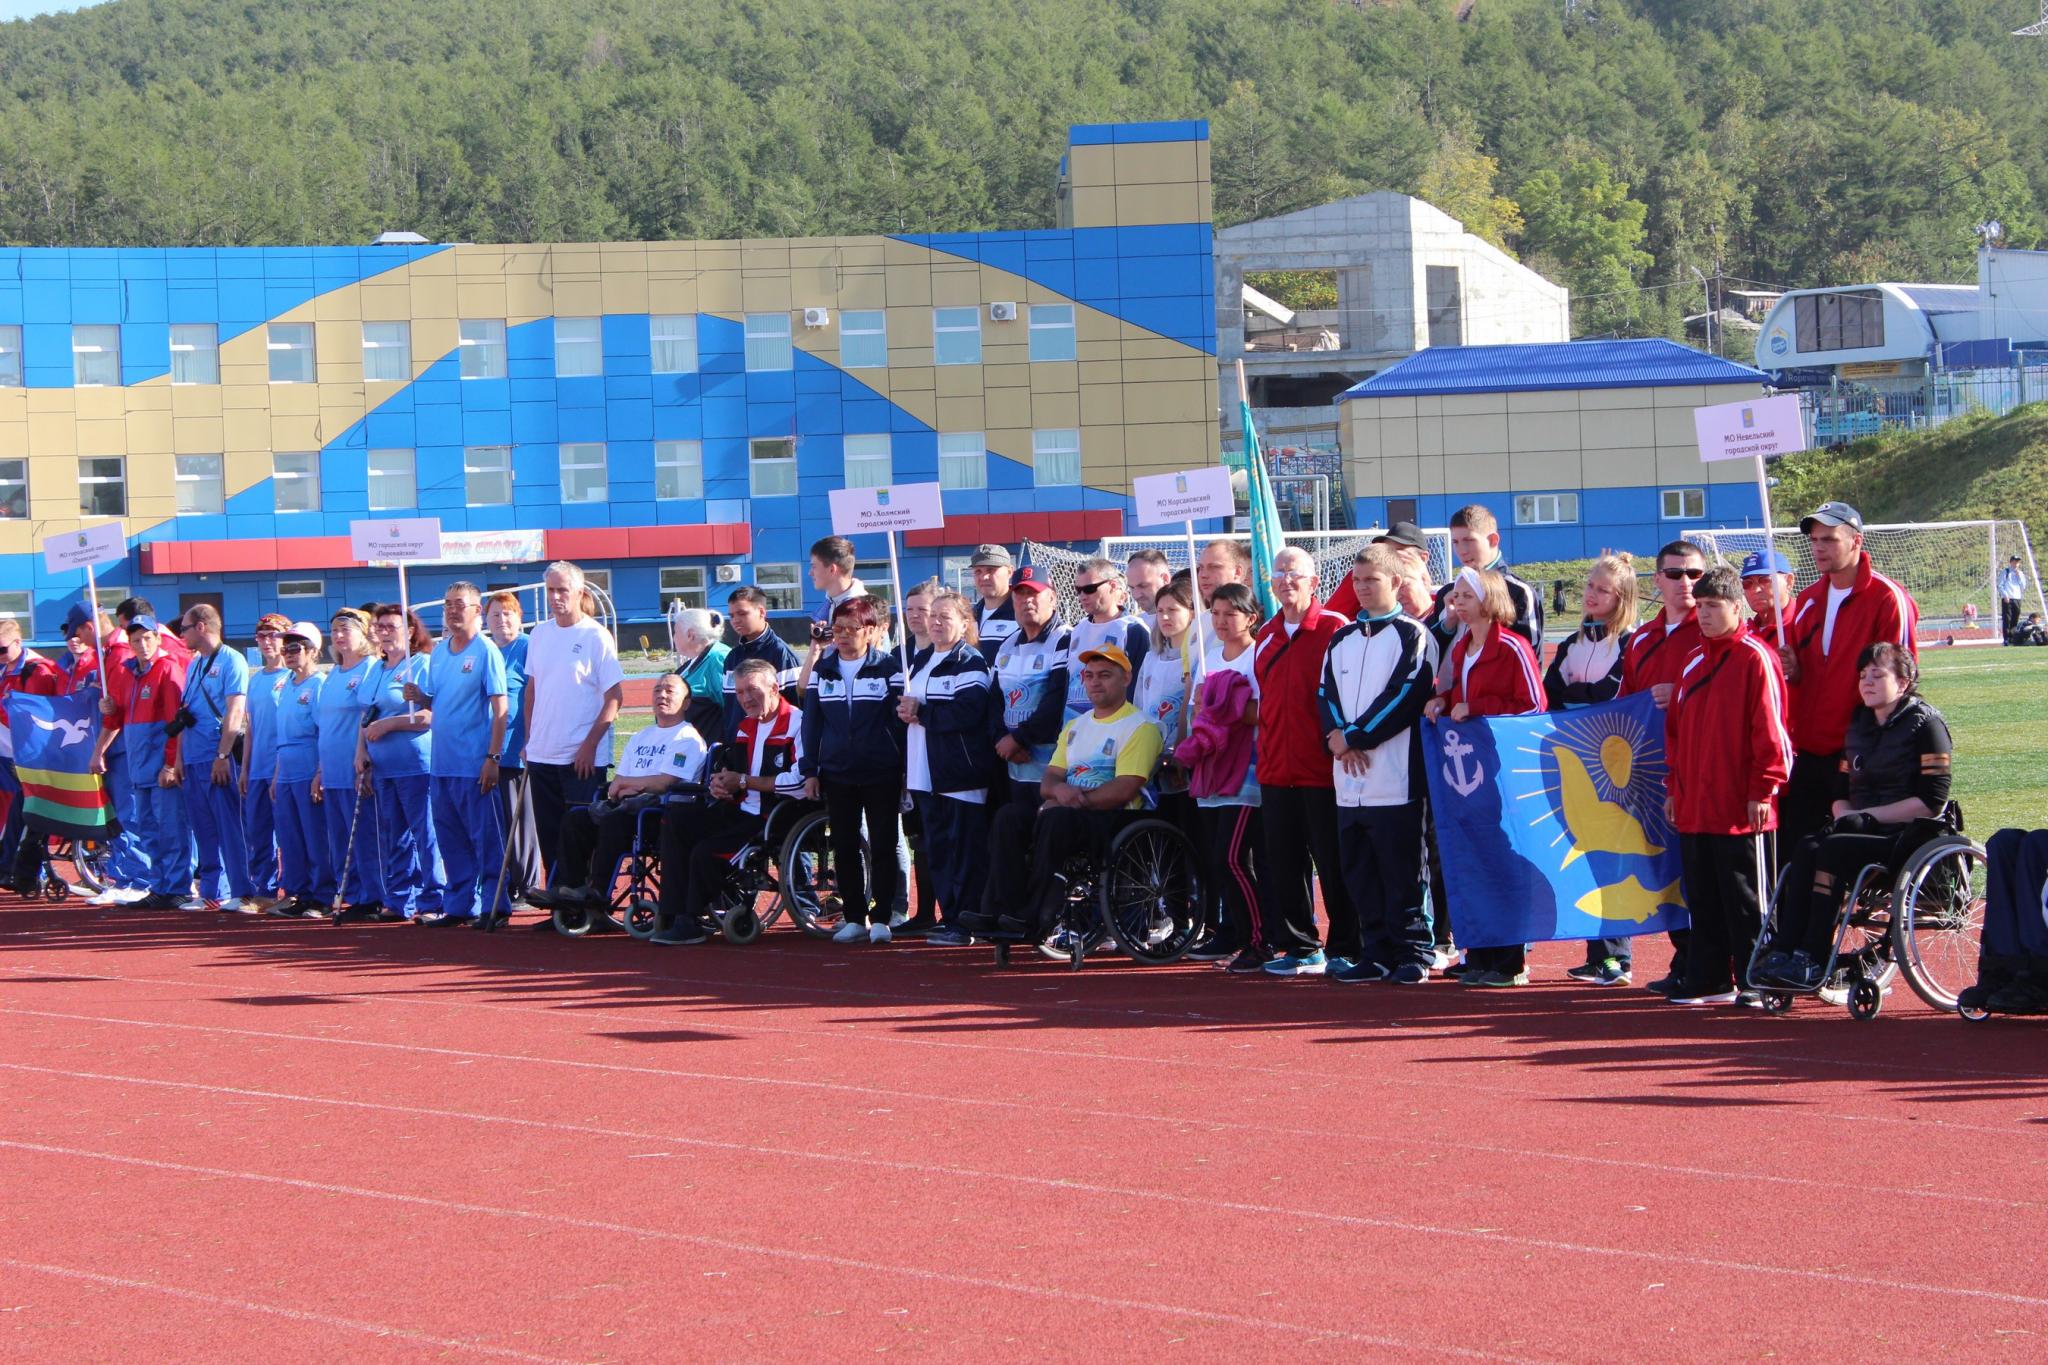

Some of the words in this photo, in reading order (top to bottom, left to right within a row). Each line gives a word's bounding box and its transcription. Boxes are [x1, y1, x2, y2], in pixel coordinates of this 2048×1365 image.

[1724, 433, 1735, 442] МО
[1737, 430, 1774, 441] Невельский
[1725, 444, 1759, 455] городской
[1760, 443, 1778, 451] округ
[1157, 499, 1167, 507] МО
[1168, 494, 1211, 506] Корсаковский
[860, 510, 872, 518] МО
[1160, 506, 1192, 518] городской
[1192, 505, 1209, 514] округ
[857, 520, 893, 529] городской
[378, 541, 407, 549] городской
[59, 550, 68, 558] МО
[68, 546, 95, 557] городской
